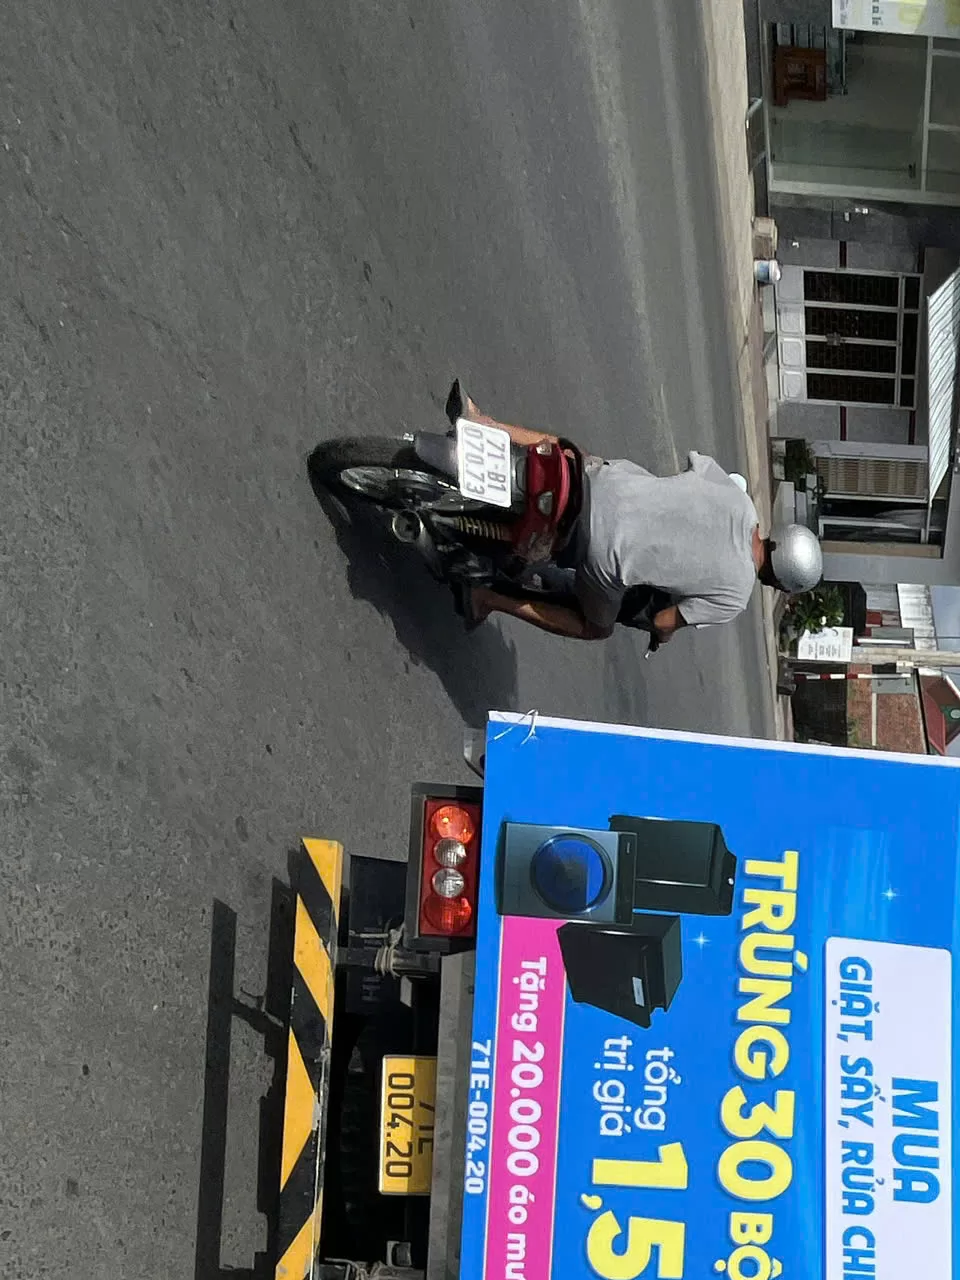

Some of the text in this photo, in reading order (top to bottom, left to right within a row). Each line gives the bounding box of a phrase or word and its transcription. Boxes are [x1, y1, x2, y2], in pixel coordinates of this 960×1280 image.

[464, 428, 485, 495] 070.73
[486, 439, 507, 492] 71-B1
[511, 957, 546, 1032] Tặng
[734, 850, 807, 1079] TRÚNG
[832, 957, 880, 1041] GIẶT,
[385, 1073, 415, 1178] 004.20
[465, 1040, 491, 1194] 71E-004.20
[507, 1040, 544, 1177] 20.000
[593, 1036, 633, 1137] trị giá
[635, 1047, 681, 1131] tổng
[837, 1055, 885, 1128] SẤY,
[718, 1086, 794, 1200] 30
[842, 1141, 884, 1215] RỬA
[892, 1078, 940, 1204] MUA
[508, 1185, 534, 1225] áo
[581, 1143, 688, 1280] 1,5
